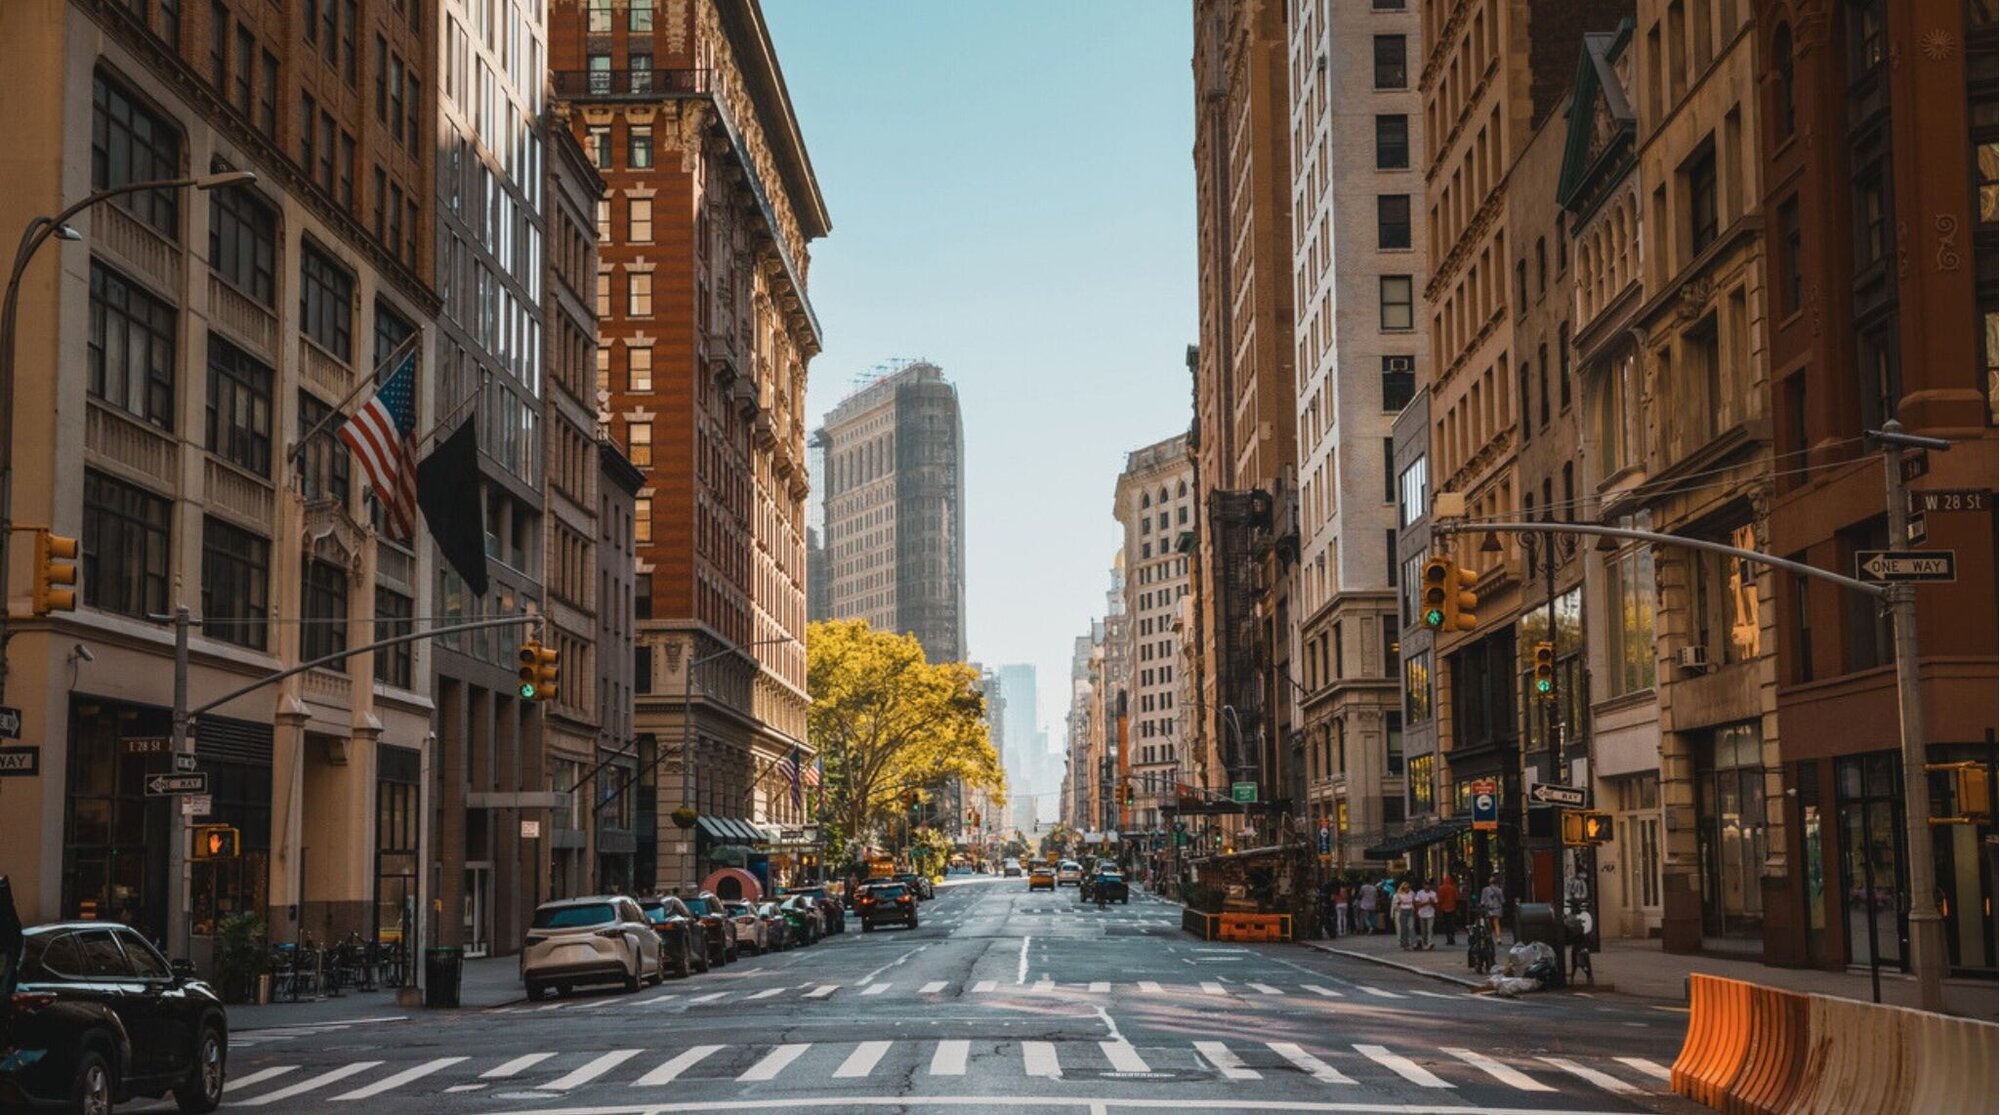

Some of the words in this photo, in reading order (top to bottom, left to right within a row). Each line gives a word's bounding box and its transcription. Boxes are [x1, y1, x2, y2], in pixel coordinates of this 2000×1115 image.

[1925, 495, 1938, 510] W
[1944, 495, 1961, 510] 28
[1967, 494, 1982, 509] St
[1872, 560, 1900, 573] ONE
[1912, 560, 1942, 572] WAY
[180, 779, 198, 788] WAY
[1562, 792, 1578, 801] WAY
